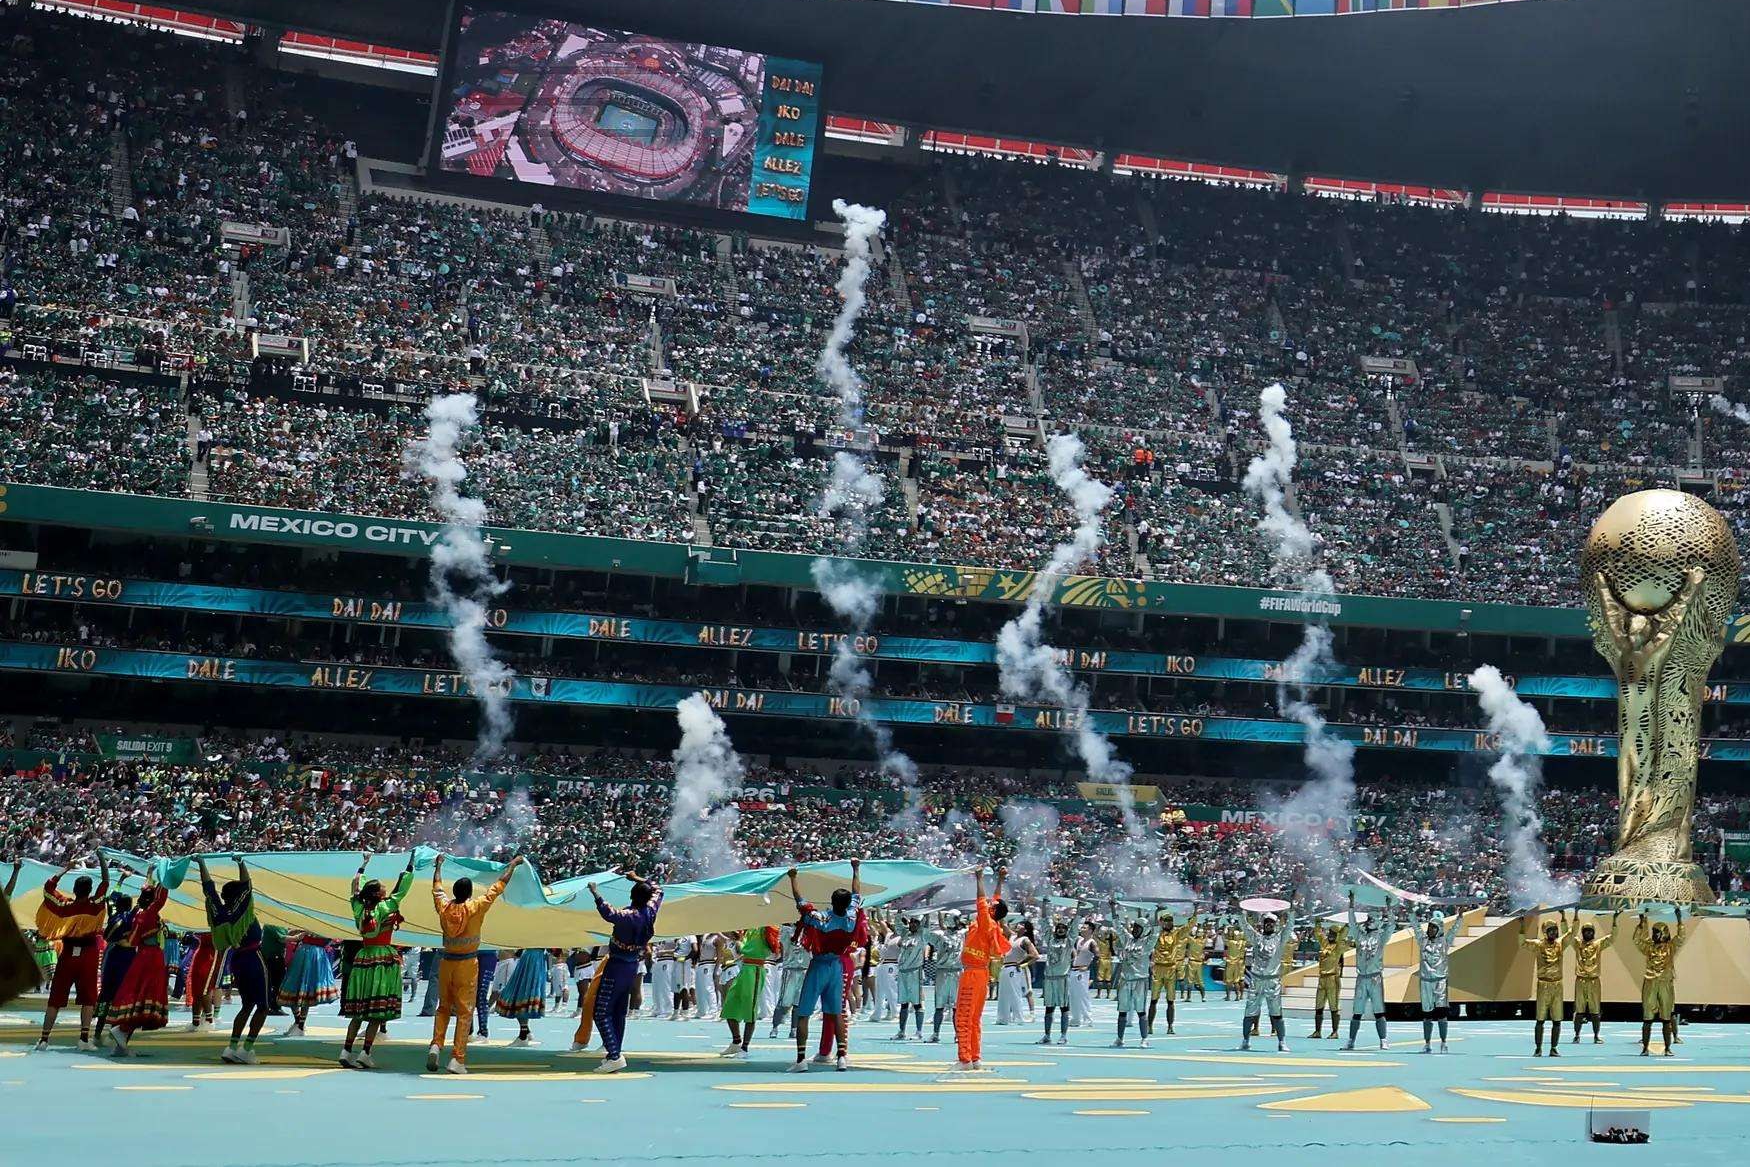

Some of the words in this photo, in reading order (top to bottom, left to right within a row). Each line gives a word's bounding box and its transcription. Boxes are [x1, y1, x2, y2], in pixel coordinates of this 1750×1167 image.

[776, 104, 801, 120] IKO
[763, 156, 802, 174] ALLEZ
[229, 513, 359, 539] MEXICO
[364, 525, 440, 546] CITY
[22, 572, 86, 598] LET'S
[91, 579, 122, 600] GO
[332, 597, 364, 618] DAI
[370, 602, 402, 621] DAI
[1259, 596, 1343, 616] #FIFAWorldCup
[483, 608, 507, 628] KO
[589, 618, 631, 639] DALE
[698, 625, 752, 647] ALLEZ
[852, 635, 878, 654] GO
[55, 647, 97, 671] IKO
[1081, 651, 1107, 669] DAI
[1166, 655, 1195, 674] IKO
[188, 659, 236, 680] DALE
[311, 667, 373, 691] ALLEZ
[1358, 667, 1405, 687] ALLEZ
[736, 692, 764, 712] DAI
[1703, 685, 1727, 702] DAI
[830, 697, 860, 716] IKO
[1128, 715, 1174, 735] LET'S
[1181, 718, 1203, 736] GO
[116, 740, 146, 751] SALIDA
[147, 741, 166, 752] EXIT
[1364, 727, 1388, 745] DAI
[1394, 730, 1418, 747] DAI
[1570, 738, 1604, 755] DALE
[727, 787, 775, 802] 026
